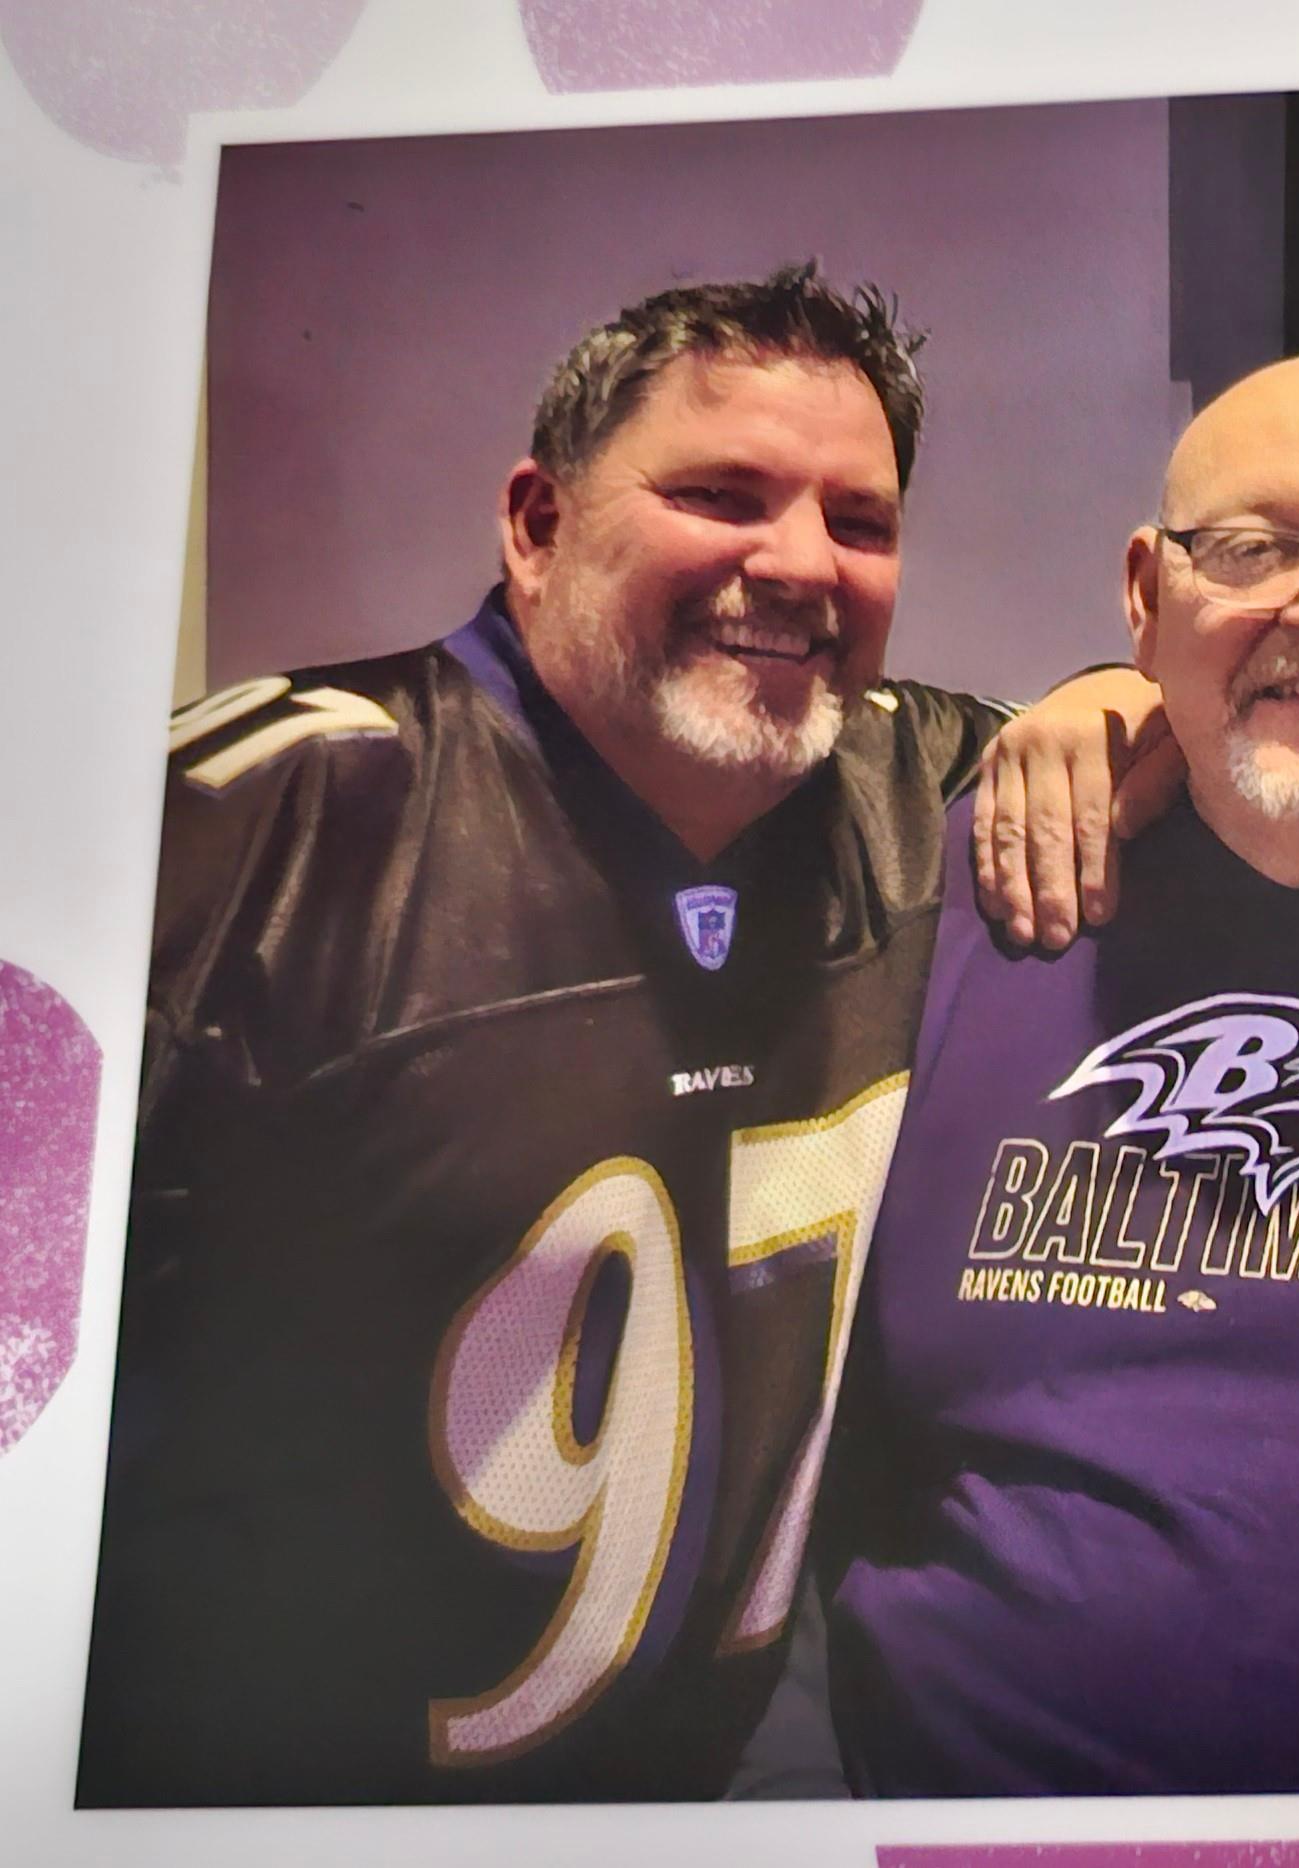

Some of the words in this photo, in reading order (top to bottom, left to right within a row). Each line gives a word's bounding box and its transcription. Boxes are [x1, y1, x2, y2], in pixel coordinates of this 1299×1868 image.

[1153, 1014, 1299, 1118] B
[958, 1266, 1044, 1304] RAVENS
[1047, 1269, 1166, 1313] FOOTBALL
[428, 1068, 911, 1767] 97
